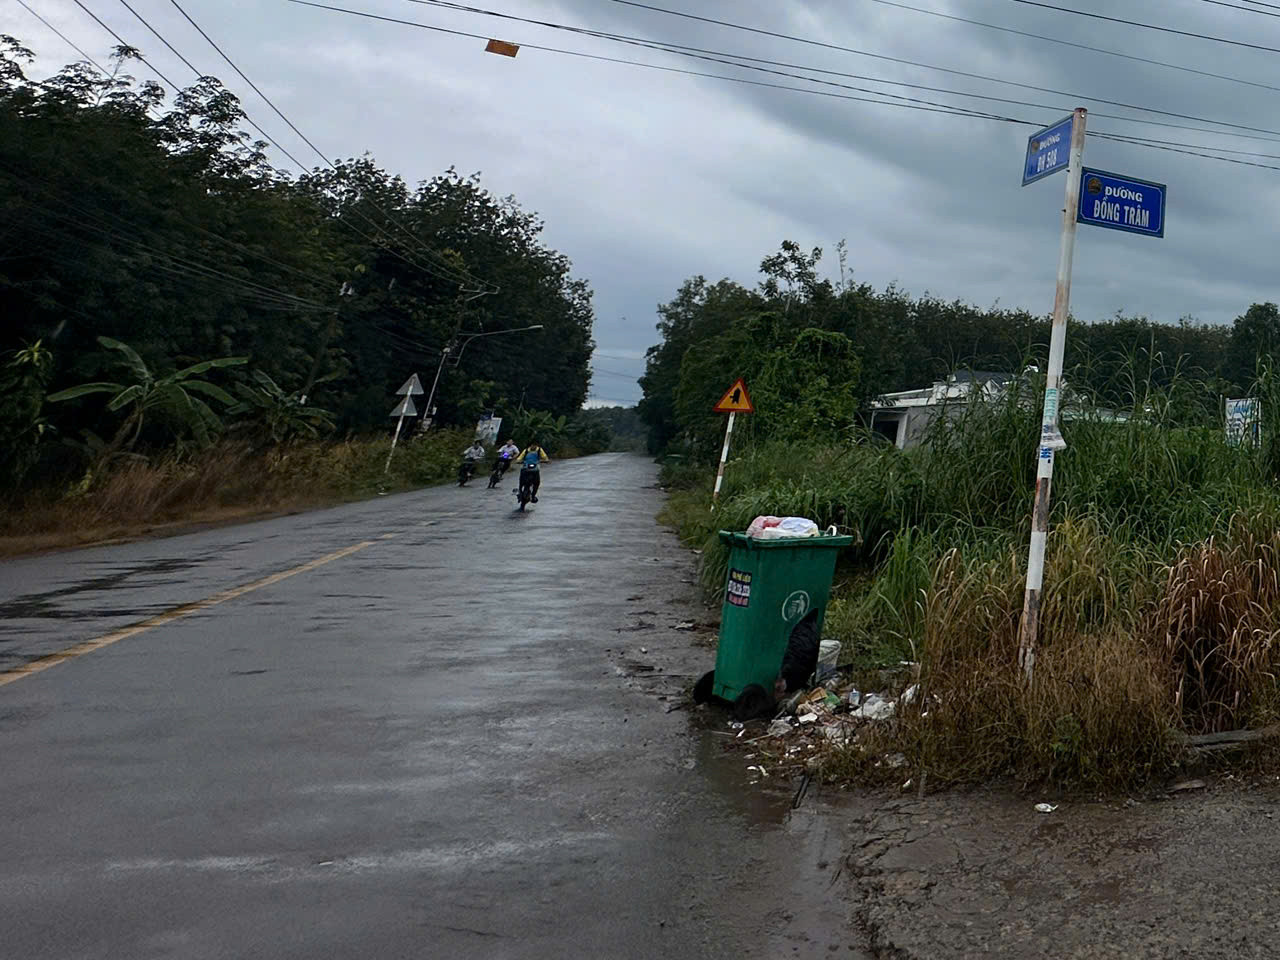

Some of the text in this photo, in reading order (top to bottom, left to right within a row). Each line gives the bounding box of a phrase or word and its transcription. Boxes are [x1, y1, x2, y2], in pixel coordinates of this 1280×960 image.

[1105, 186, 1143, 203] ĐƯỜNG
[1093, 196, 1150, 228] ĐỒNG TRÂM
